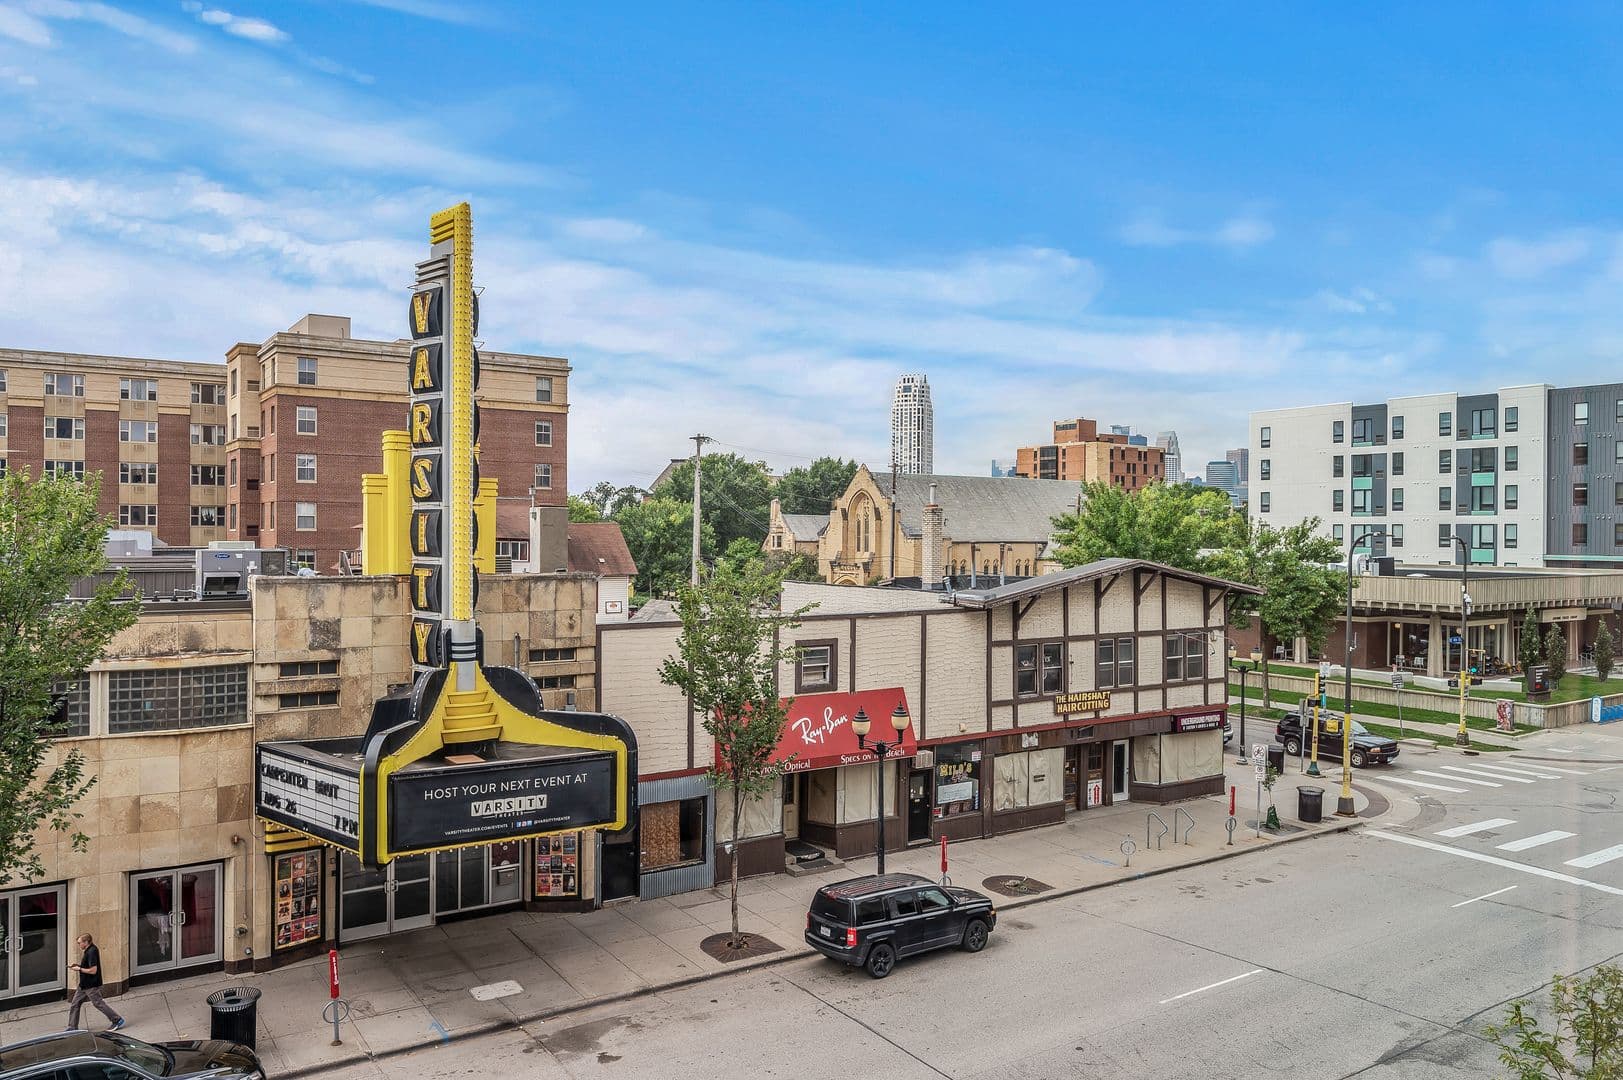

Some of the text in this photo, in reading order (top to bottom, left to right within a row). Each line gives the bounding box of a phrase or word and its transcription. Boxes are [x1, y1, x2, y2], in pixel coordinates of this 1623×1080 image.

[411, 291, 434, 664] VARSITY
[1056, 691, 1110, 703] THE HAIRSHAFT
[1057, 699, 1109, 713] HAIRCUTTING
[261, 763, 309, 790] CARPENTER
[424, 773, 588, 800] HOST YOUR NEXT EVENT AT
[472, 796, 546, 815] VARSITY
